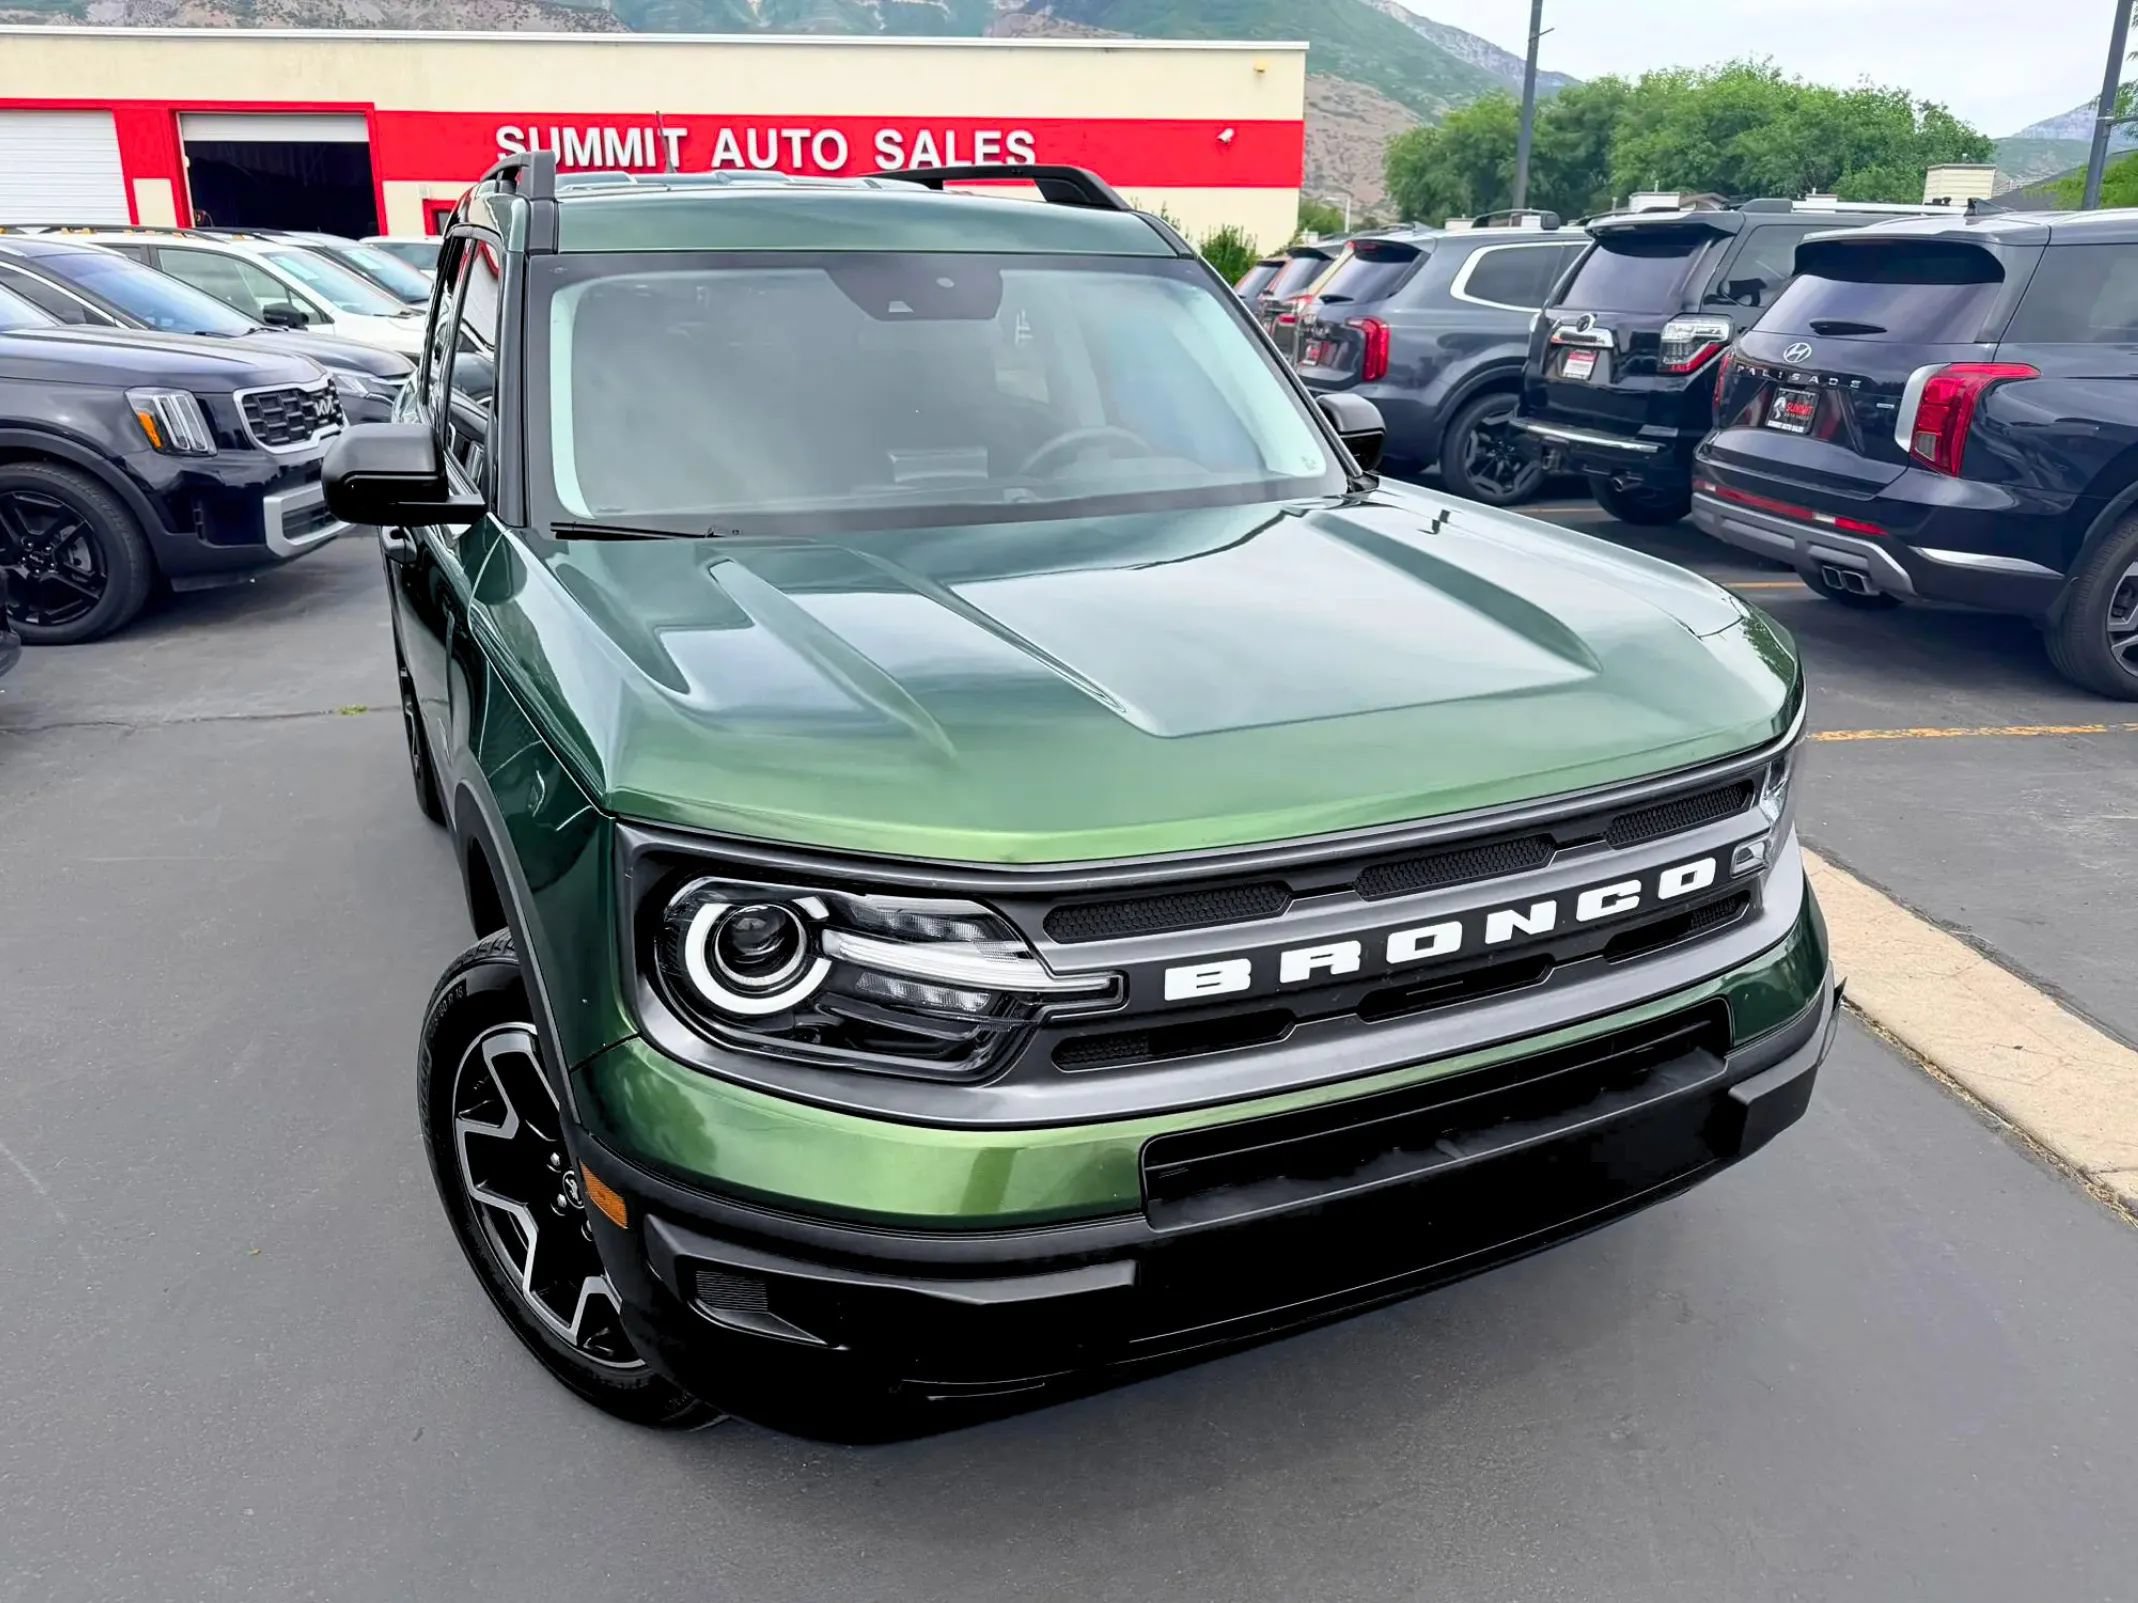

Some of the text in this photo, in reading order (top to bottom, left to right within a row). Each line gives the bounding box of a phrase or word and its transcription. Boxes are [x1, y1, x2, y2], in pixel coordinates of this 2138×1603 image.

[495, 125, 1036, 170] SUMMIT AUTO SALES
[1737, 365, 1861, 388] PALISADE
[1164, 857, 1717, 1001] BRONCO
